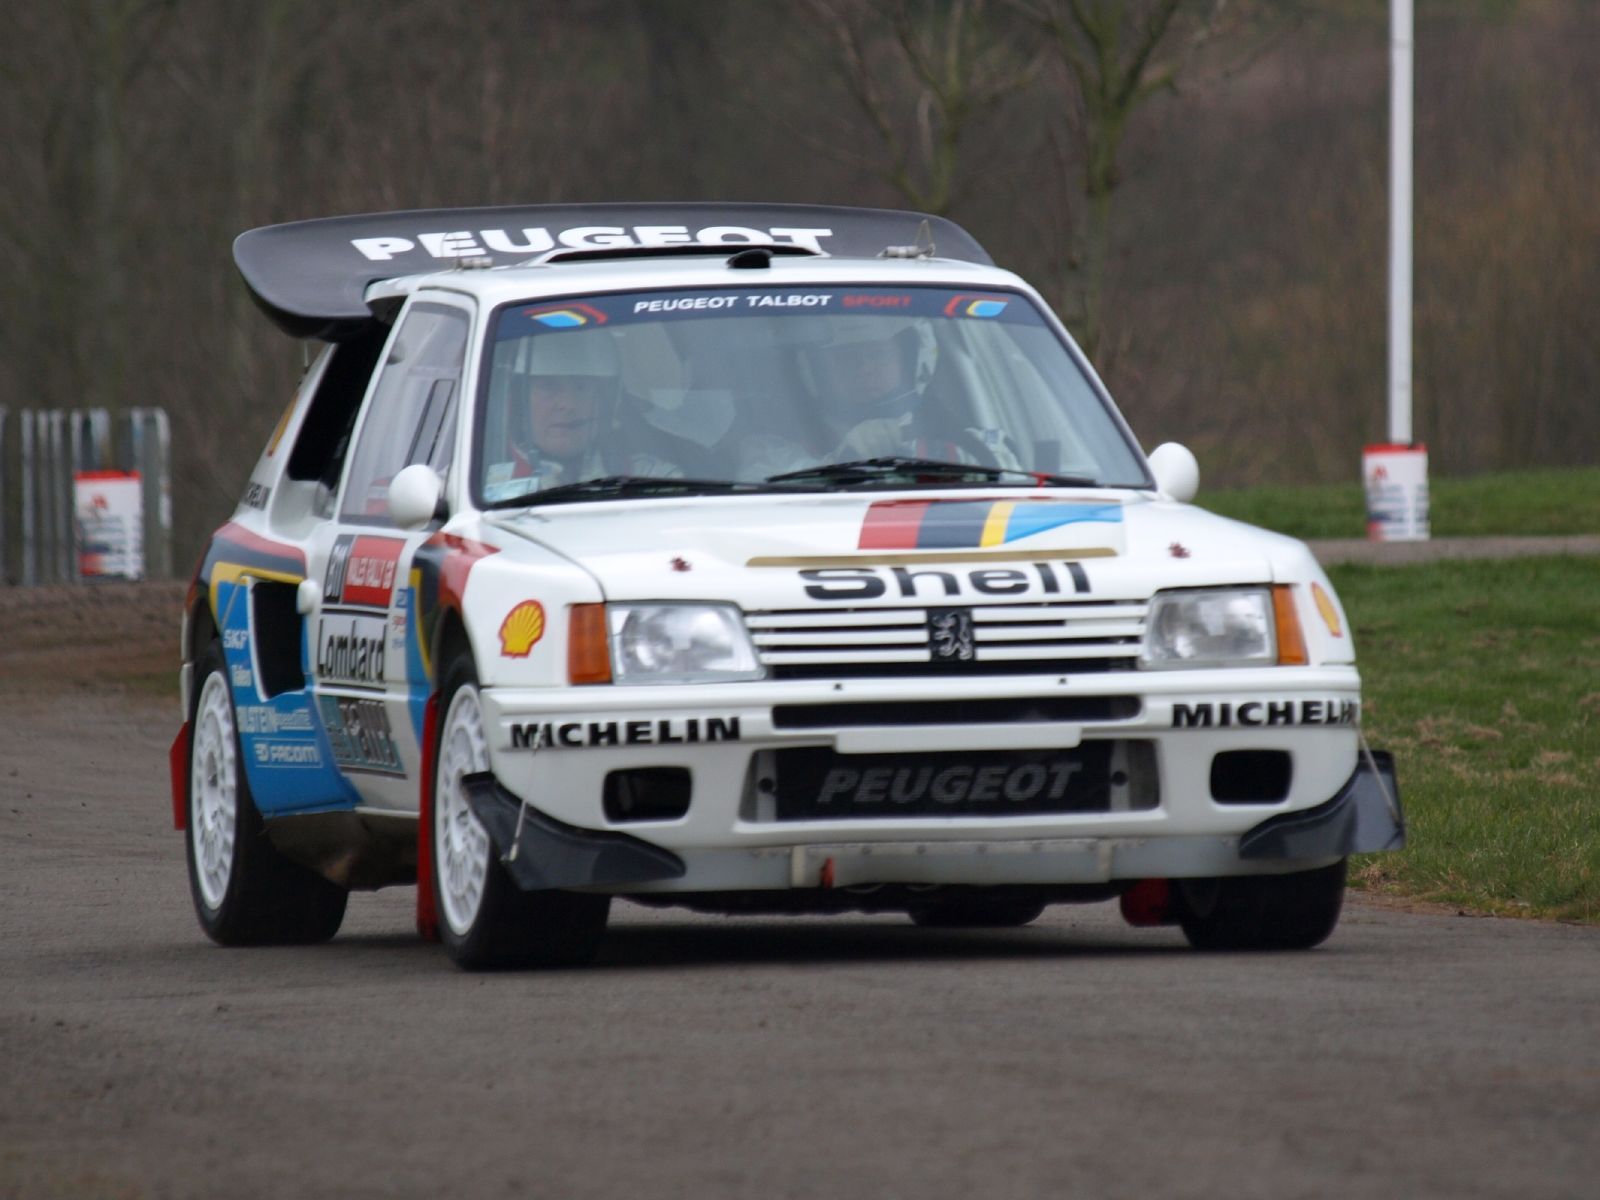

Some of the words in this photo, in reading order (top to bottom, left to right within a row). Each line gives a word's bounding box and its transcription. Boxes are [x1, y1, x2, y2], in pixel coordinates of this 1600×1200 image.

[350, 226, 833, 260] PEUGEOT
[633, 296, 738, 314] PEUGEOT
[746, 295, 833, 307] TALBOT
[842, 295, 912, 309] SPORT
[798, 562, 1092, 600] Shell
[223, 629, 248, 650] SKF
[317, 618, 388, 684] Lombard
[510, 717, 740, 748] MICHELIN
[817, 762, 1082, 804] PEUGEOT
